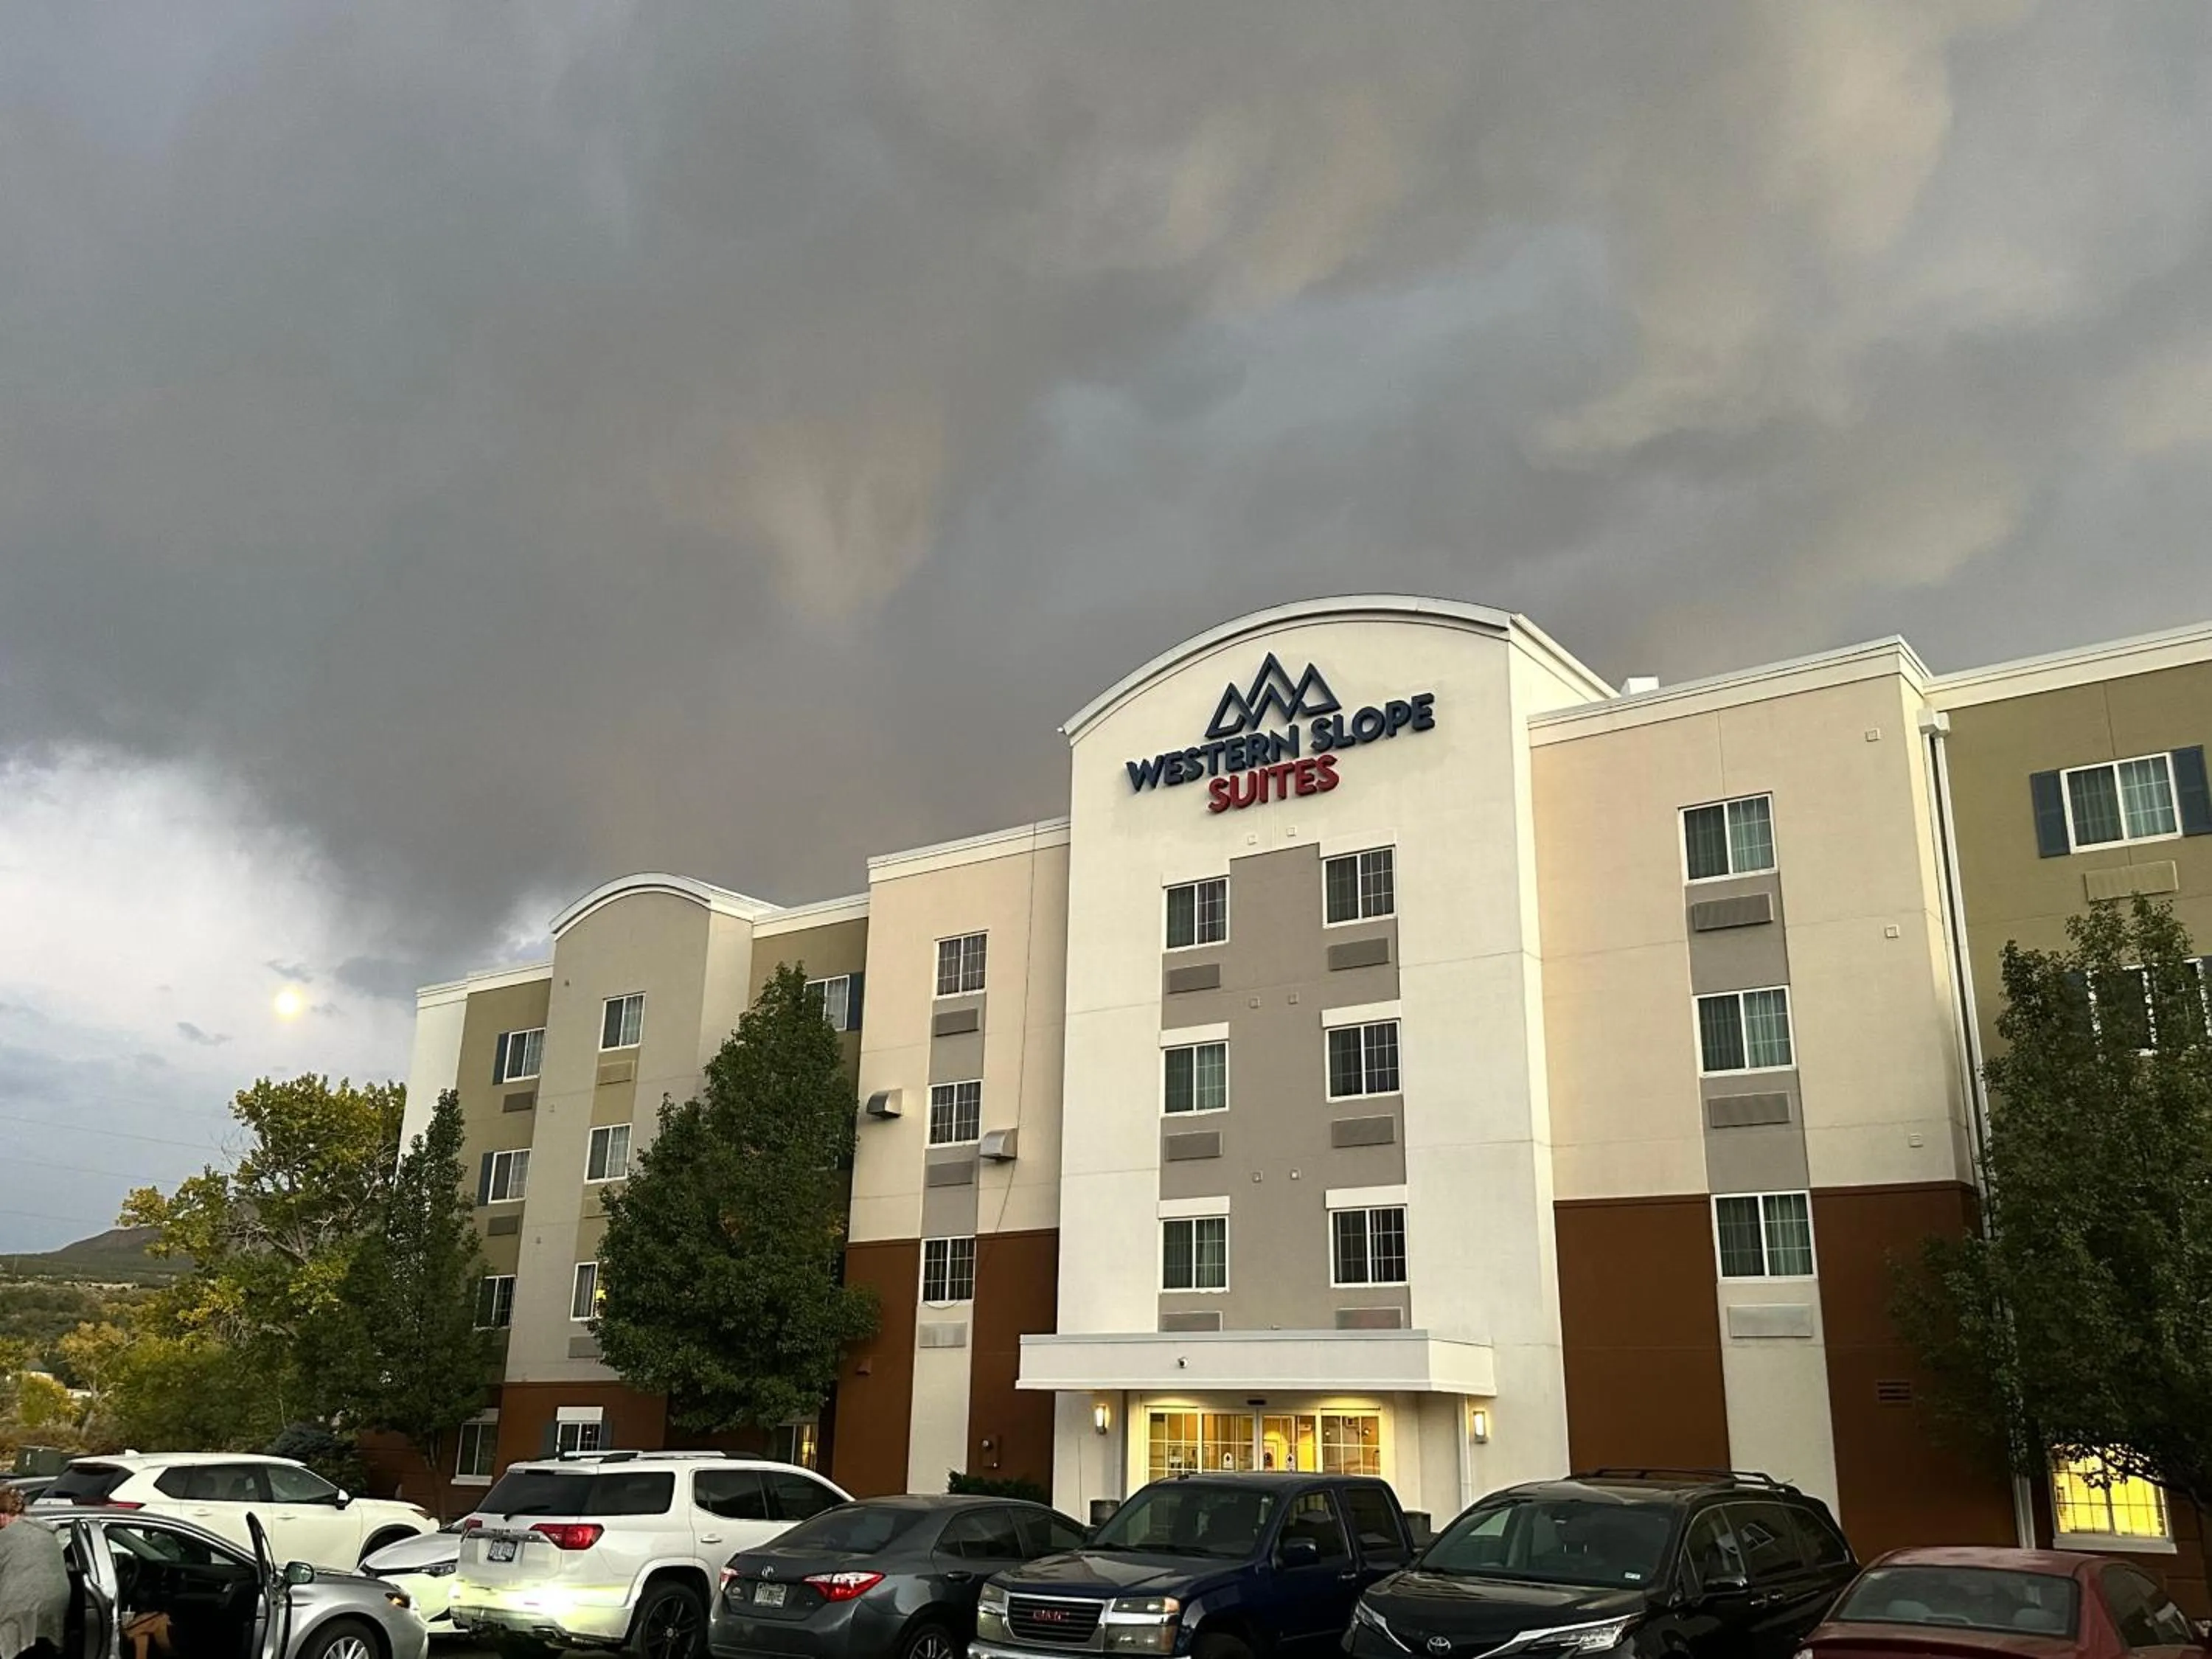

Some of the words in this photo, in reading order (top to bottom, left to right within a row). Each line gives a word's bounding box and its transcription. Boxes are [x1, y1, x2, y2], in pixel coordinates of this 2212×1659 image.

[1127, 723, 1300, 792] WESTERN
[1310, 692, 1436, 753] SLOPE
[1208, 754, 1340, 813] SUITES
